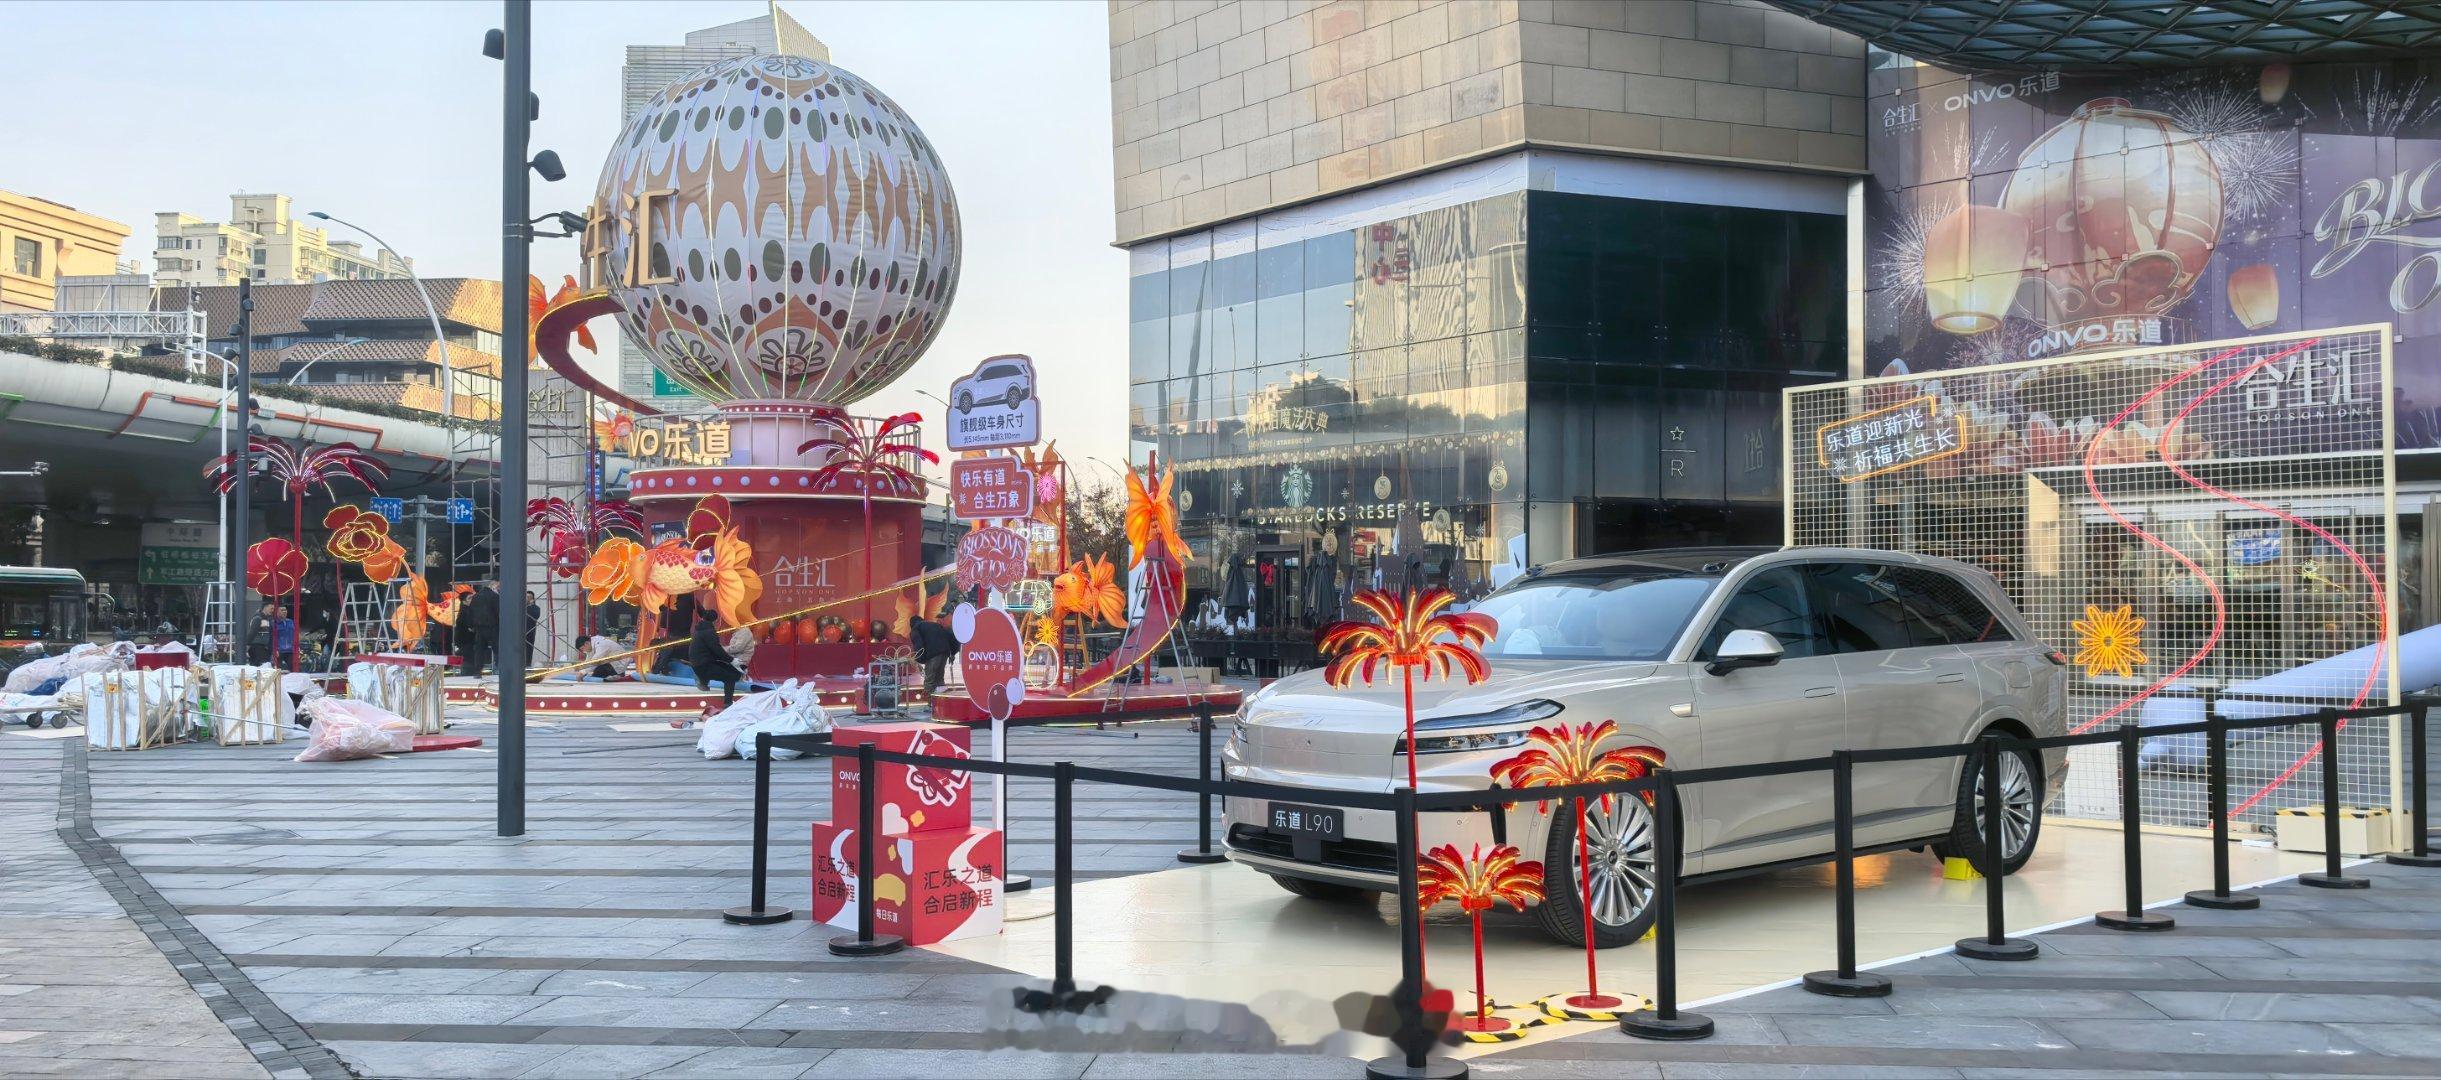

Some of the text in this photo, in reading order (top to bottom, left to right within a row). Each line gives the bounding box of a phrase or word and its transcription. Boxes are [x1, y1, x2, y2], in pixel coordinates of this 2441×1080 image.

[1944, 83, 2015, 112] ONVO
[2019, 71, 2060, 97] 乐道
[2028, 318, 2162, 357] ONVO 乐道
[2236, 349, 2372, 411] 合生汇
[664, 421, 732, 460] 乐道
[1827, 407, 1923, 452] 乐道迎新光
[1853, 427, 1956, 472] 祈福共生长
[961, 468, 1006, 488] 快乐有道
[974, 490, 1020, 509] 合生万象
[773, 555, 836, 588] 合生汇
[969, 650, 1013, 663] ONVO 乐道
[1275, 810, 1333, 834] 乐道 L90
[818, 855, 855, 879] 汇乐之道
[923, 864, 992, 891] 汇乐之道
[817, 878, 856, 903] 合启新程
[924, 889, 993, 915] 合启新程
